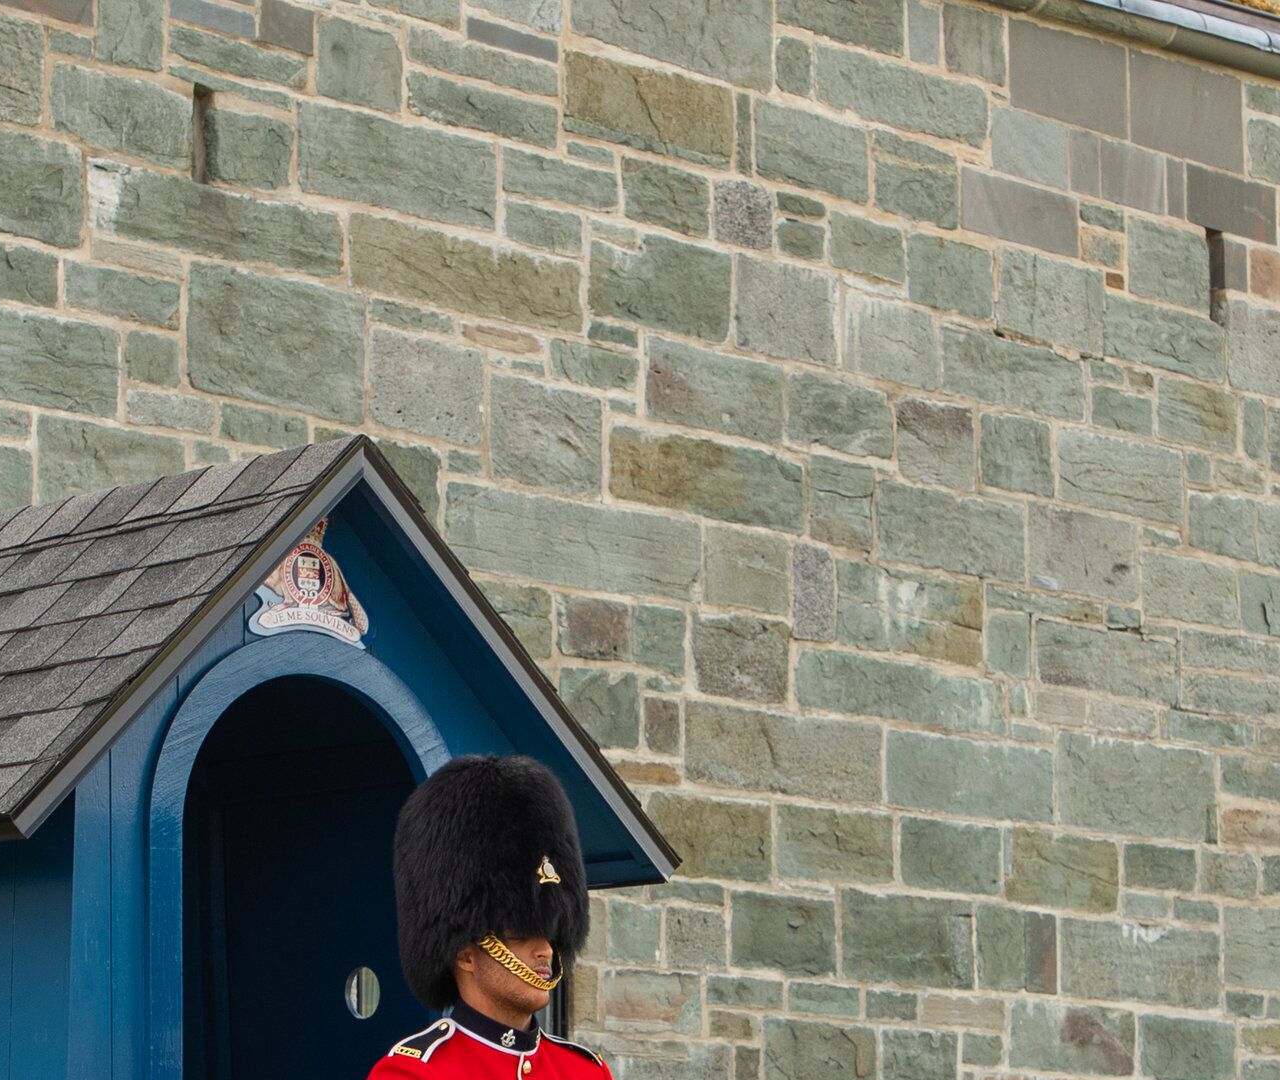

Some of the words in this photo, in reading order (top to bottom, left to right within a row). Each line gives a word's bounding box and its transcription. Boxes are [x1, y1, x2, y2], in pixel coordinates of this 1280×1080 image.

[274, 613, 283, 624] JE
[287, 611, 302, 621] ME
[305, 612, 355, 637] SOUVIENS
